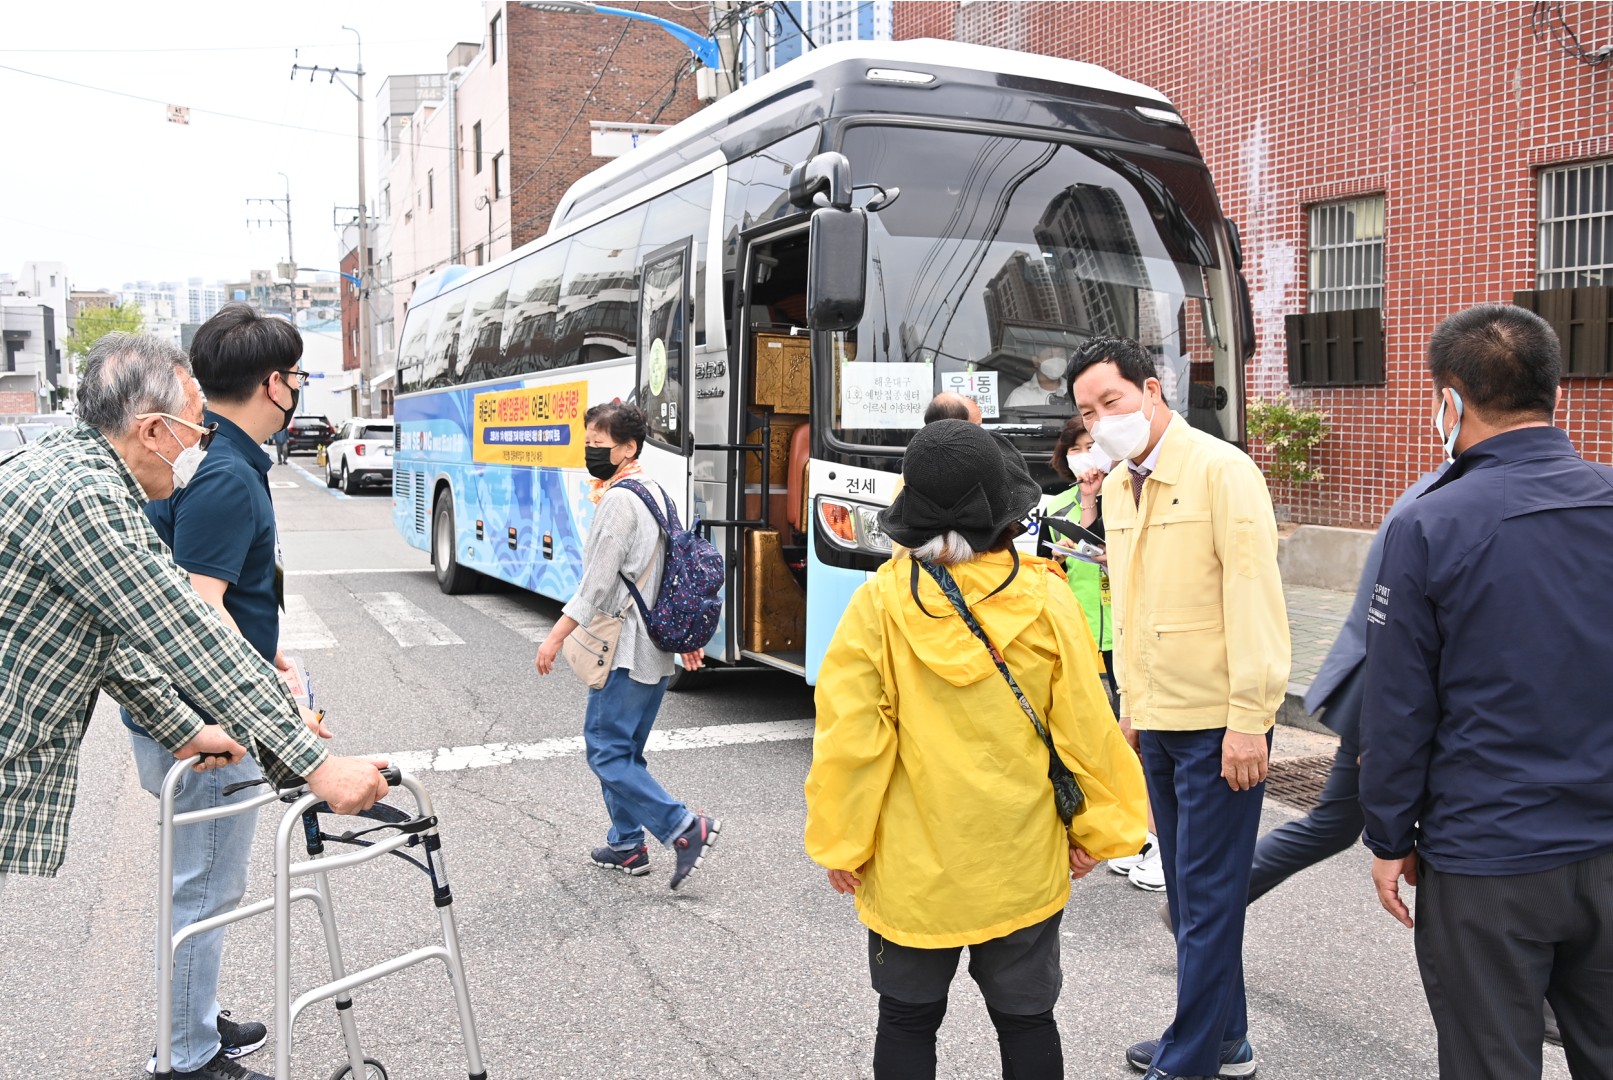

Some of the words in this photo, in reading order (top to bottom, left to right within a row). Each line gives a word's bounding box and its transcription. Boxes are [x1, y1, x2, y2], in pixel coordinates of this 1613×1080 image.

[874, 376, 911, 388] 해운대구
[949, 376, 991, 394] 우1동
[865, 389, 920, 401] 예방접종센터
[498, 395, 530, 422] 예방접종센터
[532, 393, 550, 420] 어르신
[552, 389, 579, 419] 이송차량
[889, 402, 921, 414] 이송차량
[846, 477, 876, 495] 전세
